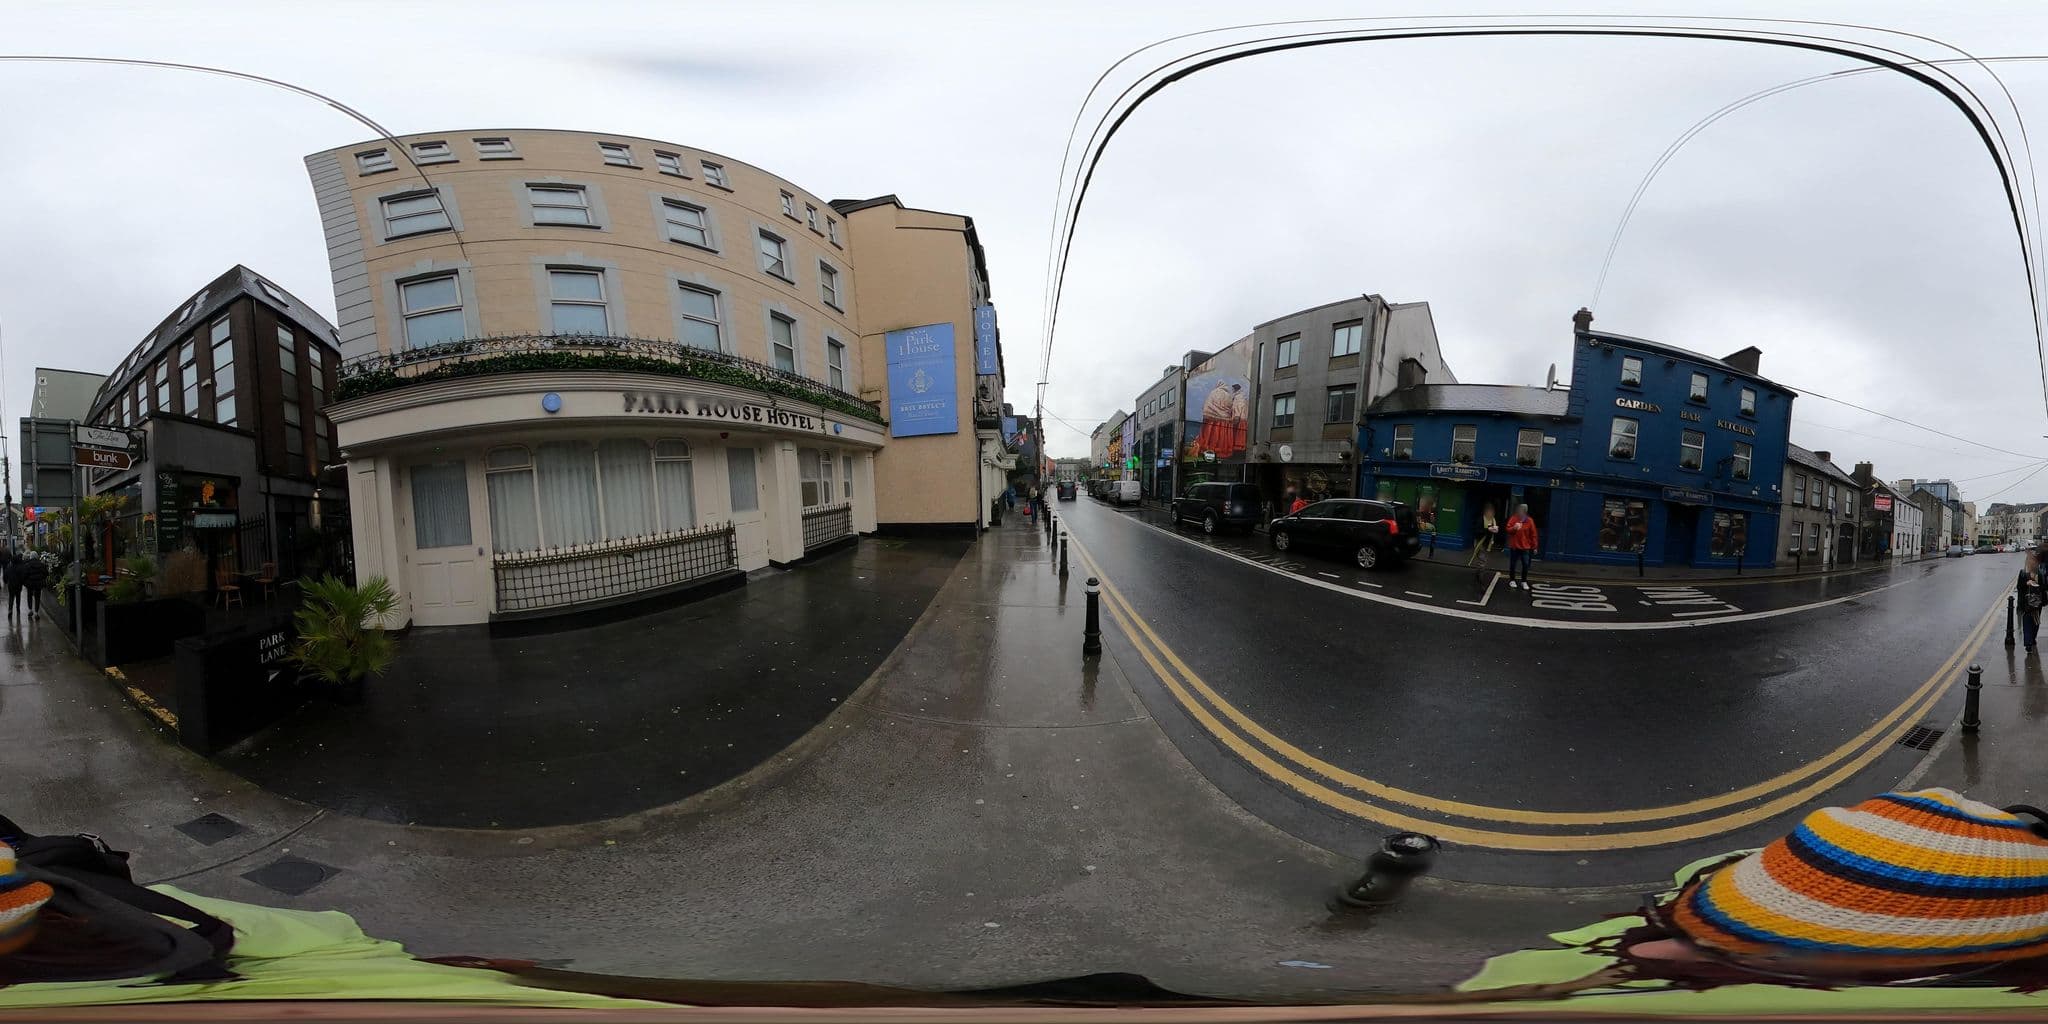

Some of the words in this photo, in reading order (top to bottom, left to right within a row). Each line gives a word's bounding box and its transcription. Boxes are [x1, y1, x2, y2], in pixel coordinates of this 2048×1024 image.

[906, 333, 937, 346] Park
[981, 310, 991, 369] HOTEL
[899, 343, 941, 356] House
[697, 399, 763, 422] HOUSE
[767, 407, 814, 430] HOTEL
[1615, 397, 1663, 414] GARDEN
[1680, 410, 1702, 422] BAR
[1717, 419, 1756, 437] KITCHEN
[93, 450, 118, 463] bunk
[1531, 583, 1618, 612] BUS
[260, 631, 285, 650] PARK
[260, 645, 287, 664] LANE
